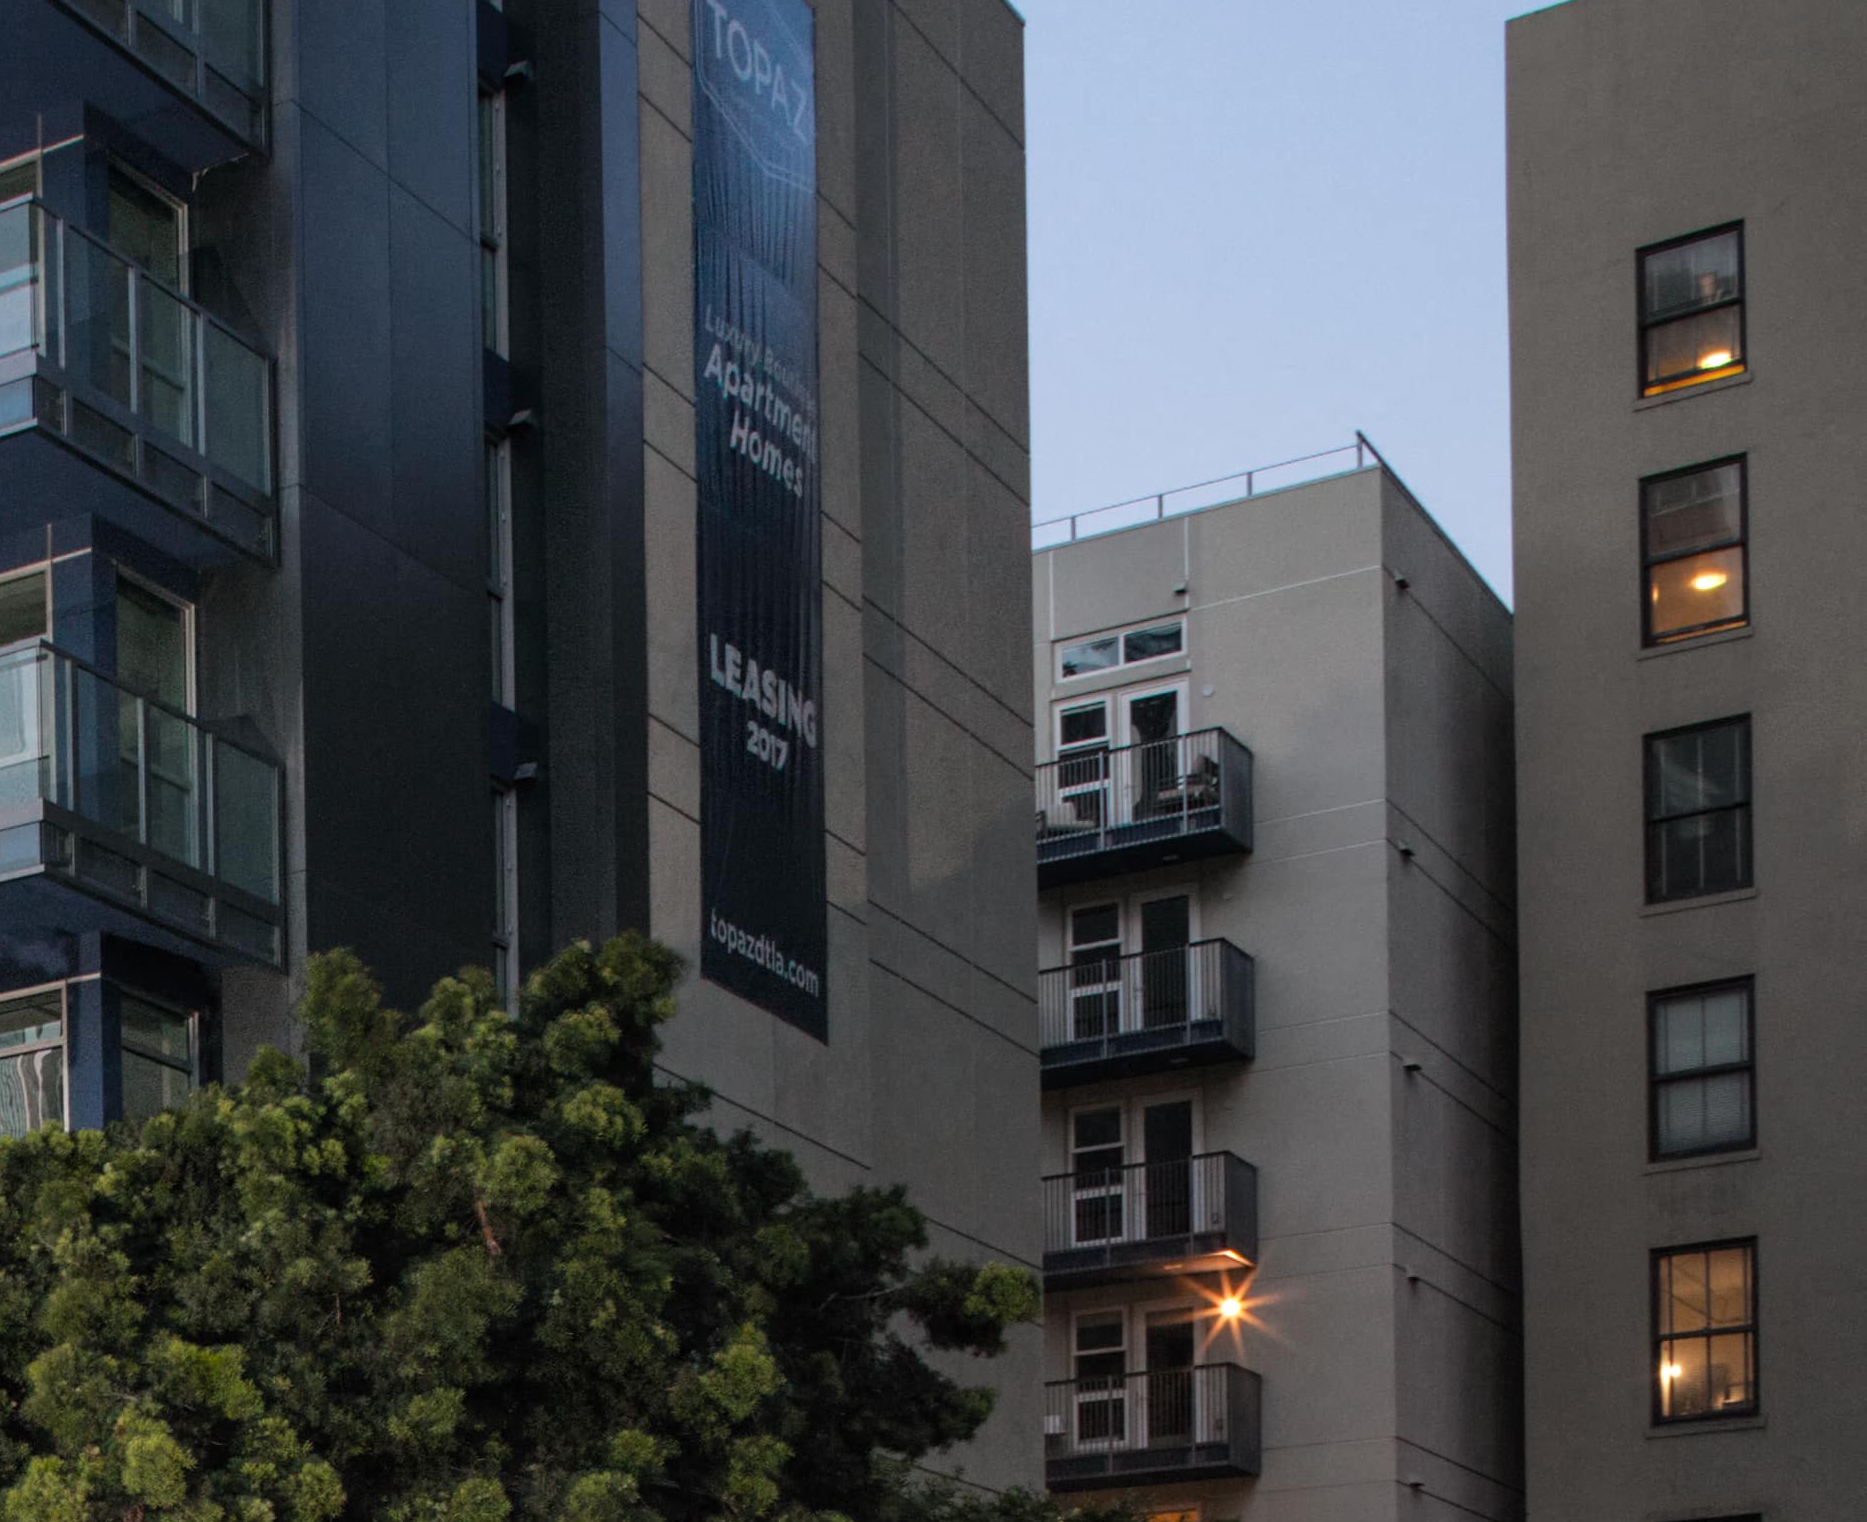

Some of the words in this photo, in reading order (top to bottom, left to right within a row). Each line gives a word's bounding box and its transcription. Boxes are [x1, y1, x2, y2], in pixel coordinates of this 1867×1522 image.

[705, 305, 762, 366] Luxury
[704, 343, 816, 464] Apartment
[730, 409, 803, 498] Homes
[709, 633, 817, 748] LEASING
[746, 720, 788, 770] 2017
[711, 908, 819, 998] topazdtla.com
